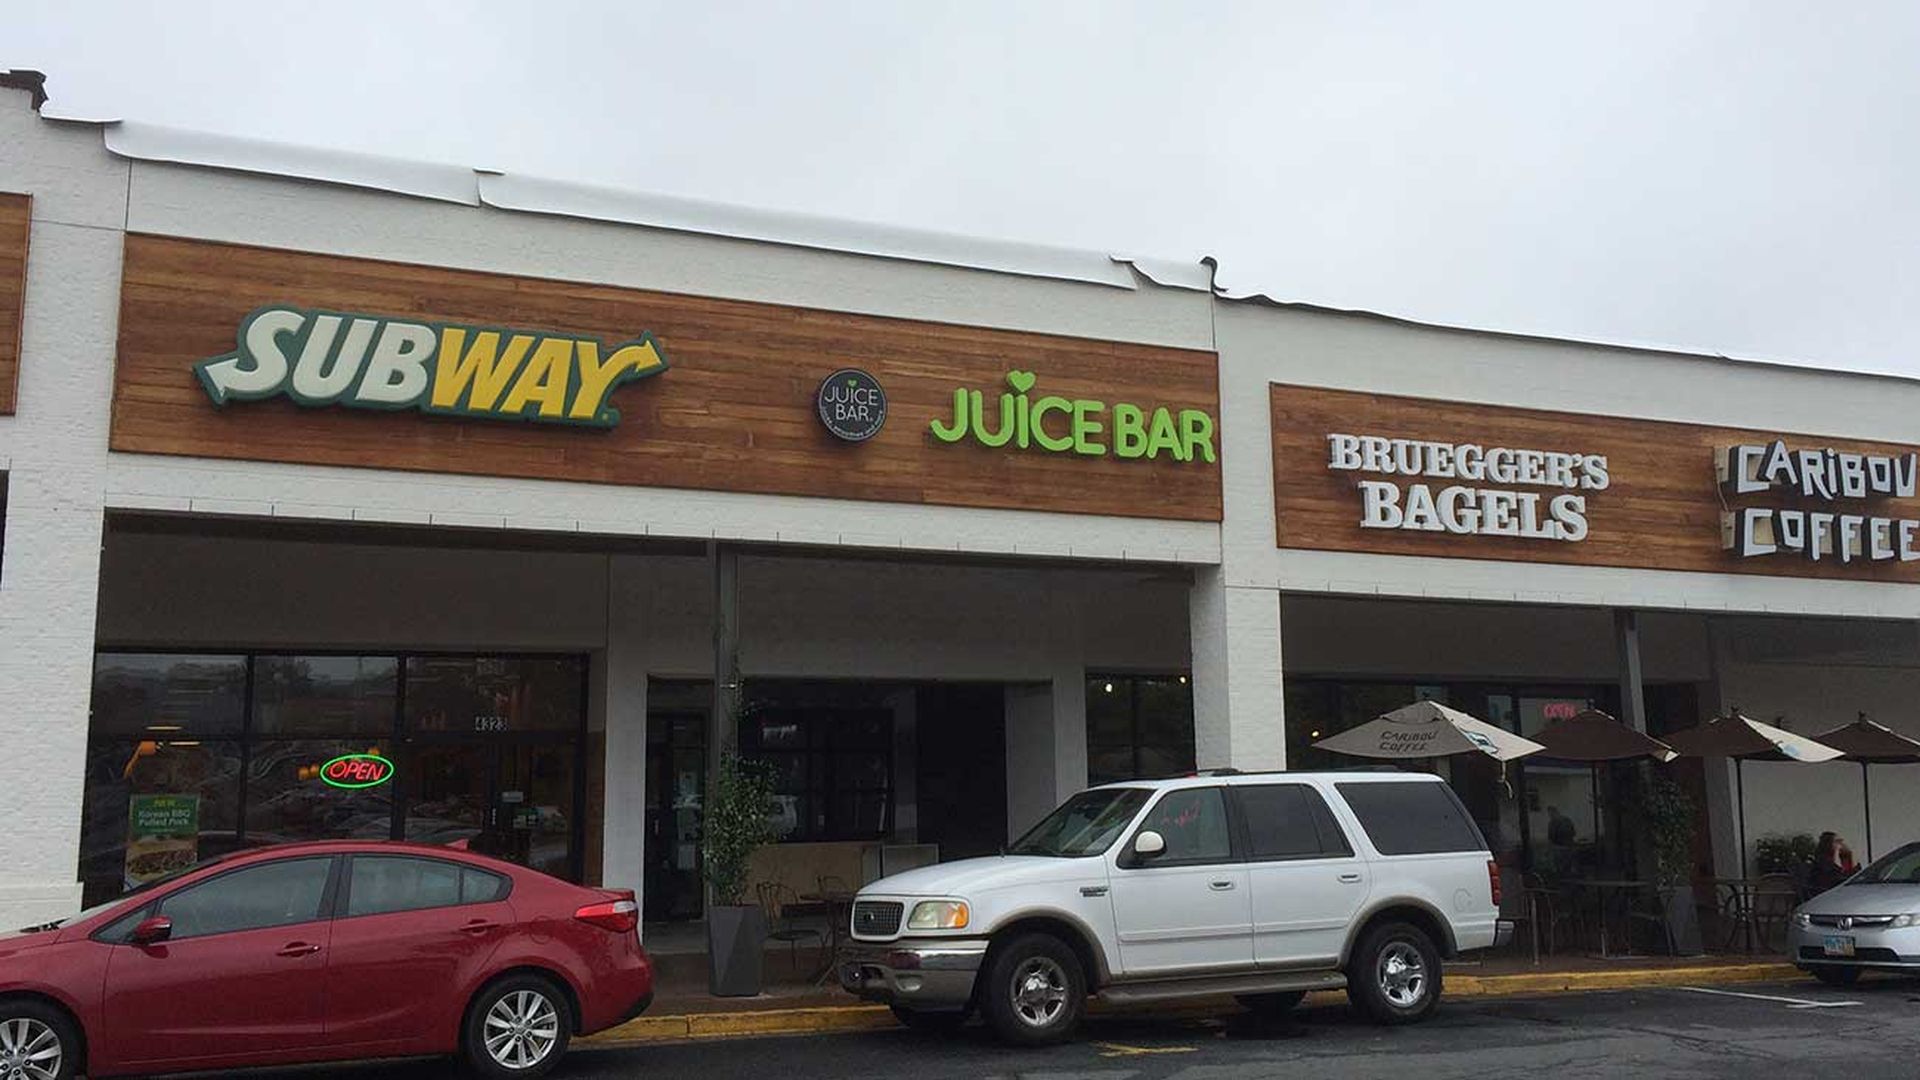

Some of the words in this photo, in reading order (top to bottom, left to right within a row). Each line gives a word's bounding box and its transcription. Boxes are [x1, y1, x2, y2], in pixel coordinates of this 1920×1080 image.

[203, 307, 663, 420] SUBWAY
[824, 385, 879, 406] JUICE
[929, 385, 1107, 456] JUICE
[1112, 402, 1217, 464] BAR
[1327, 433, 1610, 490] BRUEGGER'S
[1357, 480, 1589, 542] BAGELS
[1741, 506, 1920, 564] COFFEE
[1380, 741, 1428, 752] COFFEE
[1382, 730, 1439, 741] CARIBOU
[328, 760, 386, 780] OPEN
